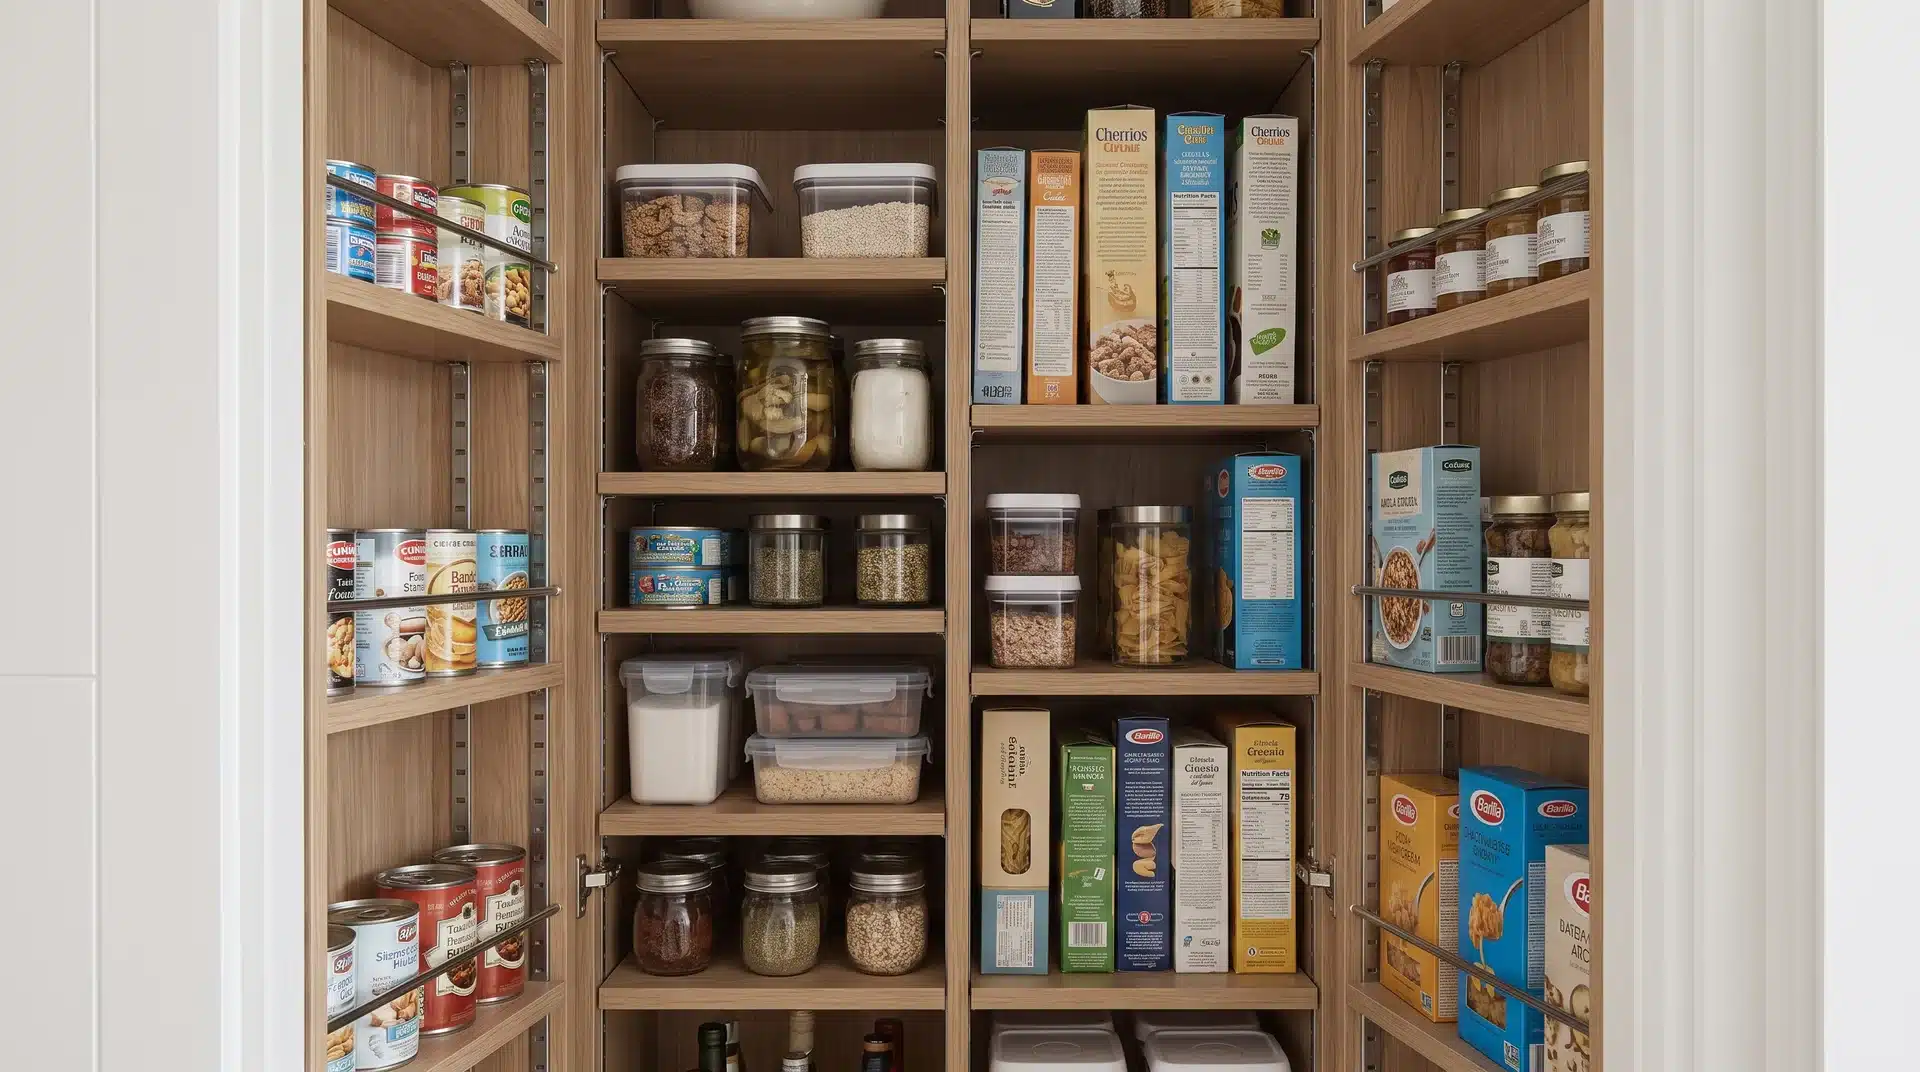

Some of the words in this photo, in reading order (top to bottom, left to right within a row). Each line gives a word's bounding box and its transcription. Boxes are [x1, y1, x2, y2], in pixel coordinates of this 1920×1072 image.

[1095, 128, 1148, 142] Cherrios
[1251, 126, 1290, 137] Cherrios
[1477, 797, 1502, 818] Barilla
[1546, 803, 1574, 813] Barilla
